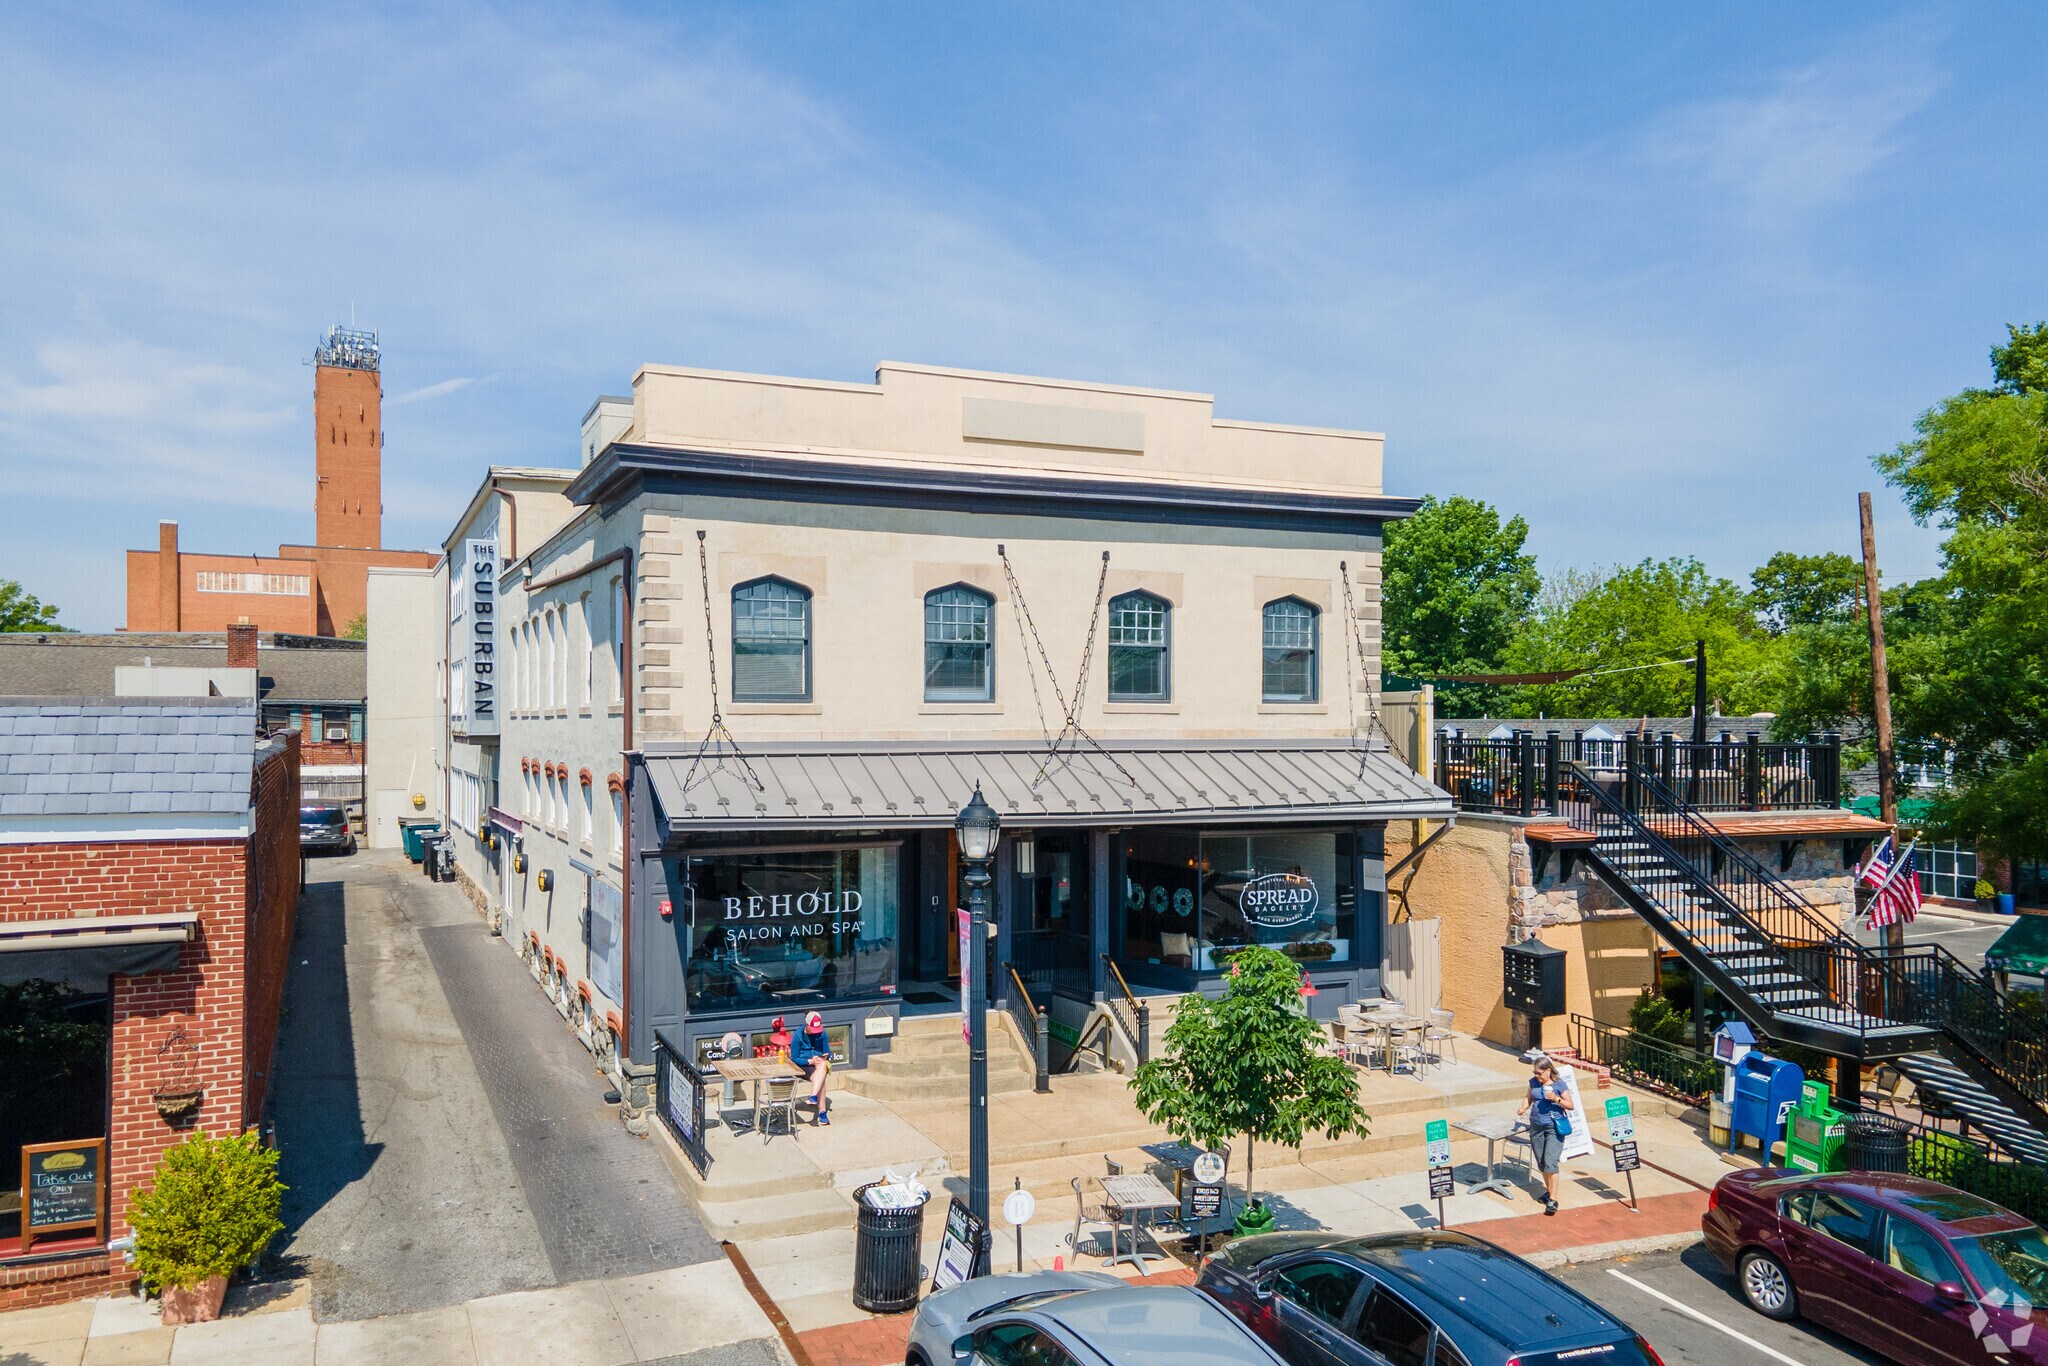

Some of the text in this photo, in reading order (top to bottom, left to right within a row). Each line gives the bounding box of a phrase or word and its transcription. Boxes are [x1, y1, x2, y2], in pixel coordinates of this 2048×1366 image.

[473, 544, 493, 553] THE
[474, 562, 493, 714] SUBURBAN
[724, 888, 863, 920] BEHOLD
[1248, 889, 1312, 905] SPREAD
[1255, 904, 1305, 912] BAGELRY
[727, 926, 782, 941] SALON
[790, 924, 824, 936] AND
[32, 1171, 93, 1187] Take Out
[49, 1185, 73, 1194] ONLY
[33, 1198, 44, 1208] No
